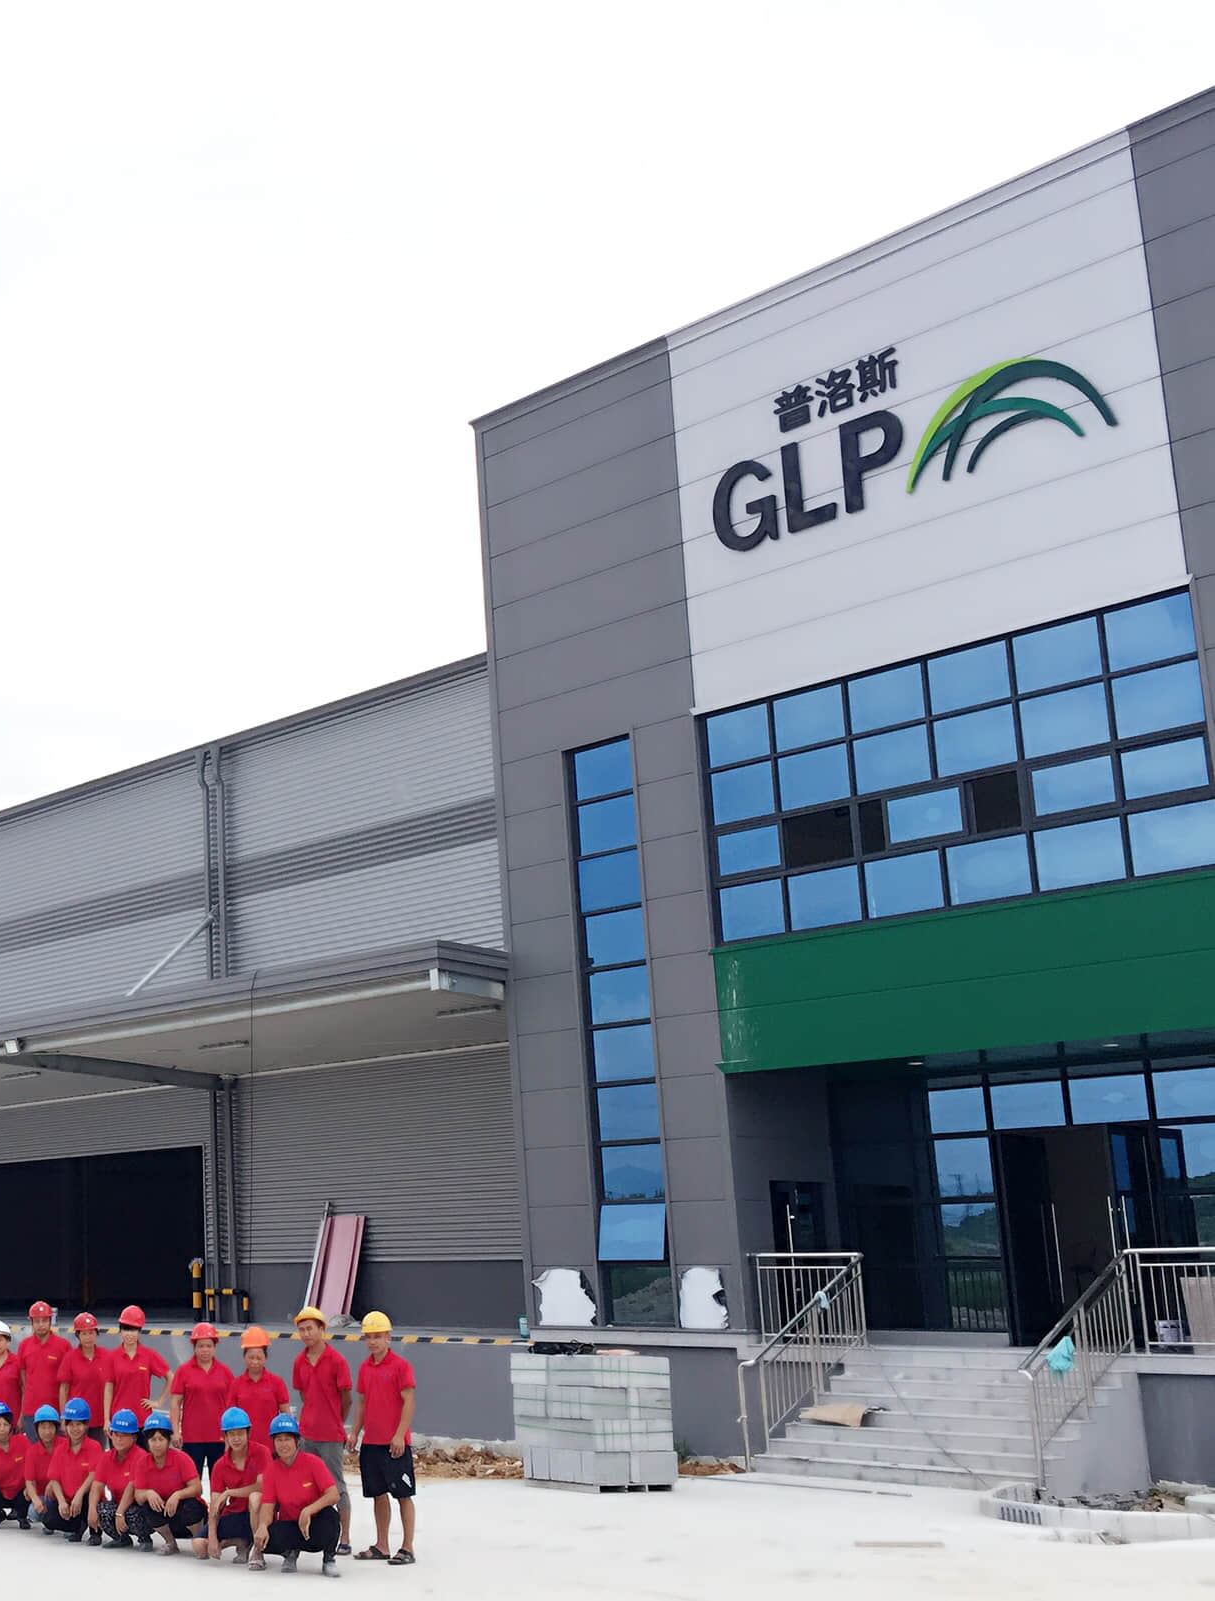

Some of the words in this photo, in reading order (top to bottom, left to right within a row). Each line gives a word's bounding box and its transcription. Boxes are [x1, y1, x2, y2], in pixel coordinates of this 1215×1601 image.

[773, 347, 899, 433] 普洛斯
[712, 409, 904, 552] GLP
